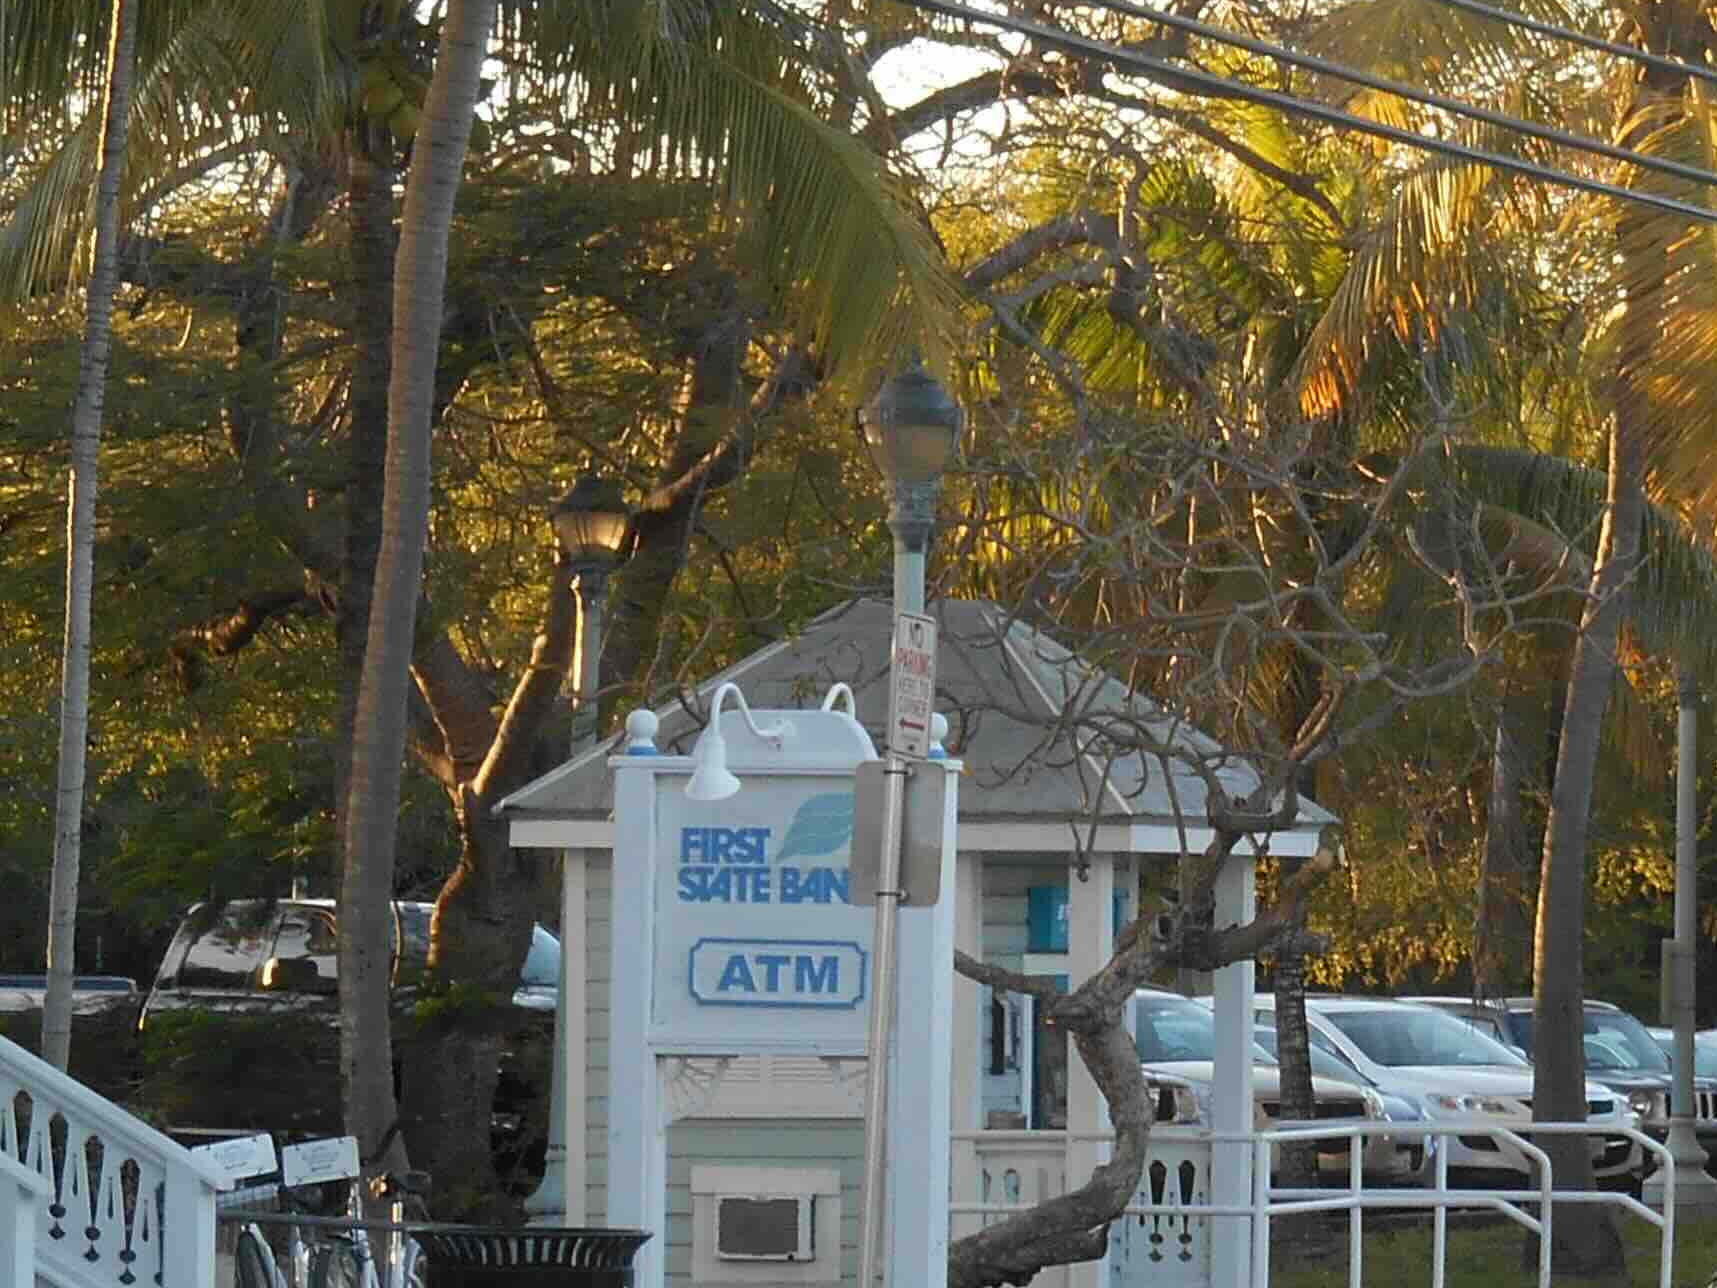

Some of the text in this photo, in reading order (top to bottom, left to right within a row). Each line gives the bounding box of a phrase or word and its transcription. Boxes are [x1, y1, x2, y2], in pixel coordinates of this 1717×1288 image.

[681, 827, 771, 864] FIRST
[677, 866, 851, 903] STATE BAN
[717, 954, 839, 993] ATM
